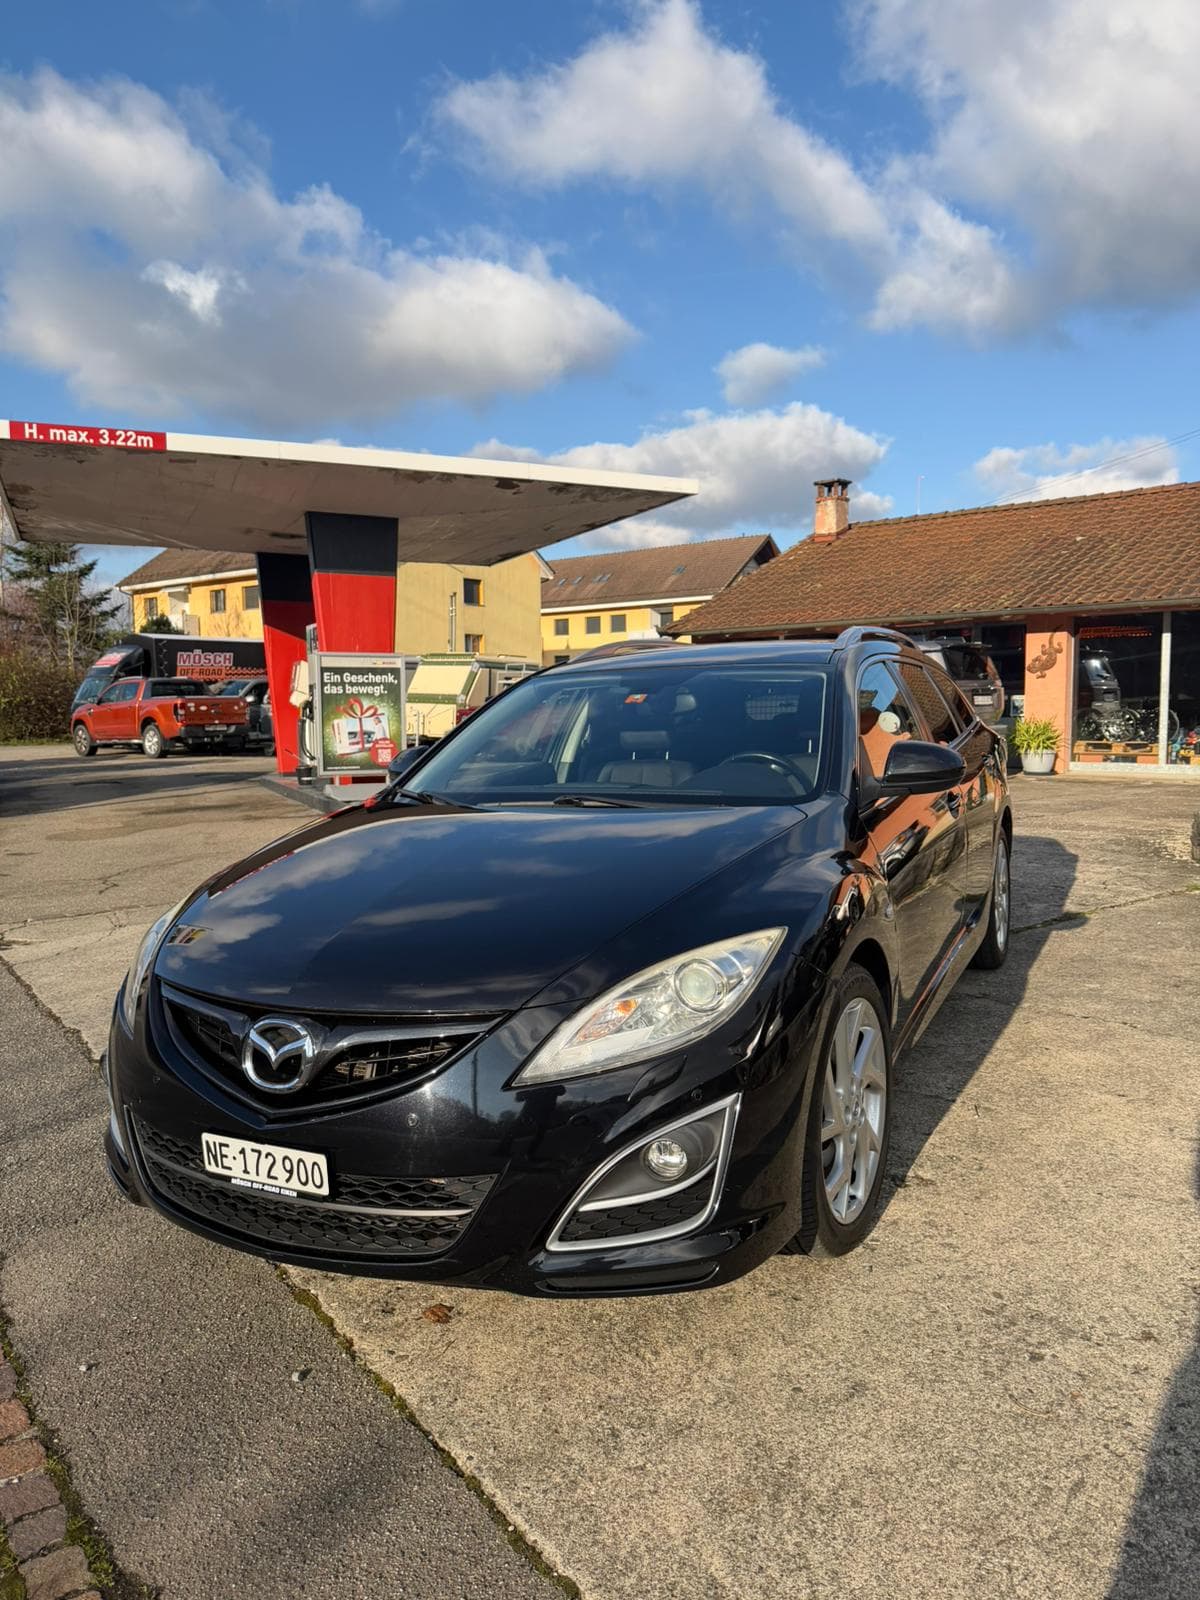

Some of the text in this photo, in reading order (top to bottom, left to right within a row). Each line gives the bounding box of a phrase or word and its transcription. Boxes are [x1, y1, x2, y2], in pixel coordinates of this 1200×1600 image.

[24, 422, 154, 448] H. max. 3.22m
[177, 649, 234, 666] MÖSCH
[179, 667, 223, 677] OFF-ROAD
[323, 672, 398, 685] Ein Geschenk,
[323, 684, 388, 697] das bewegt.
